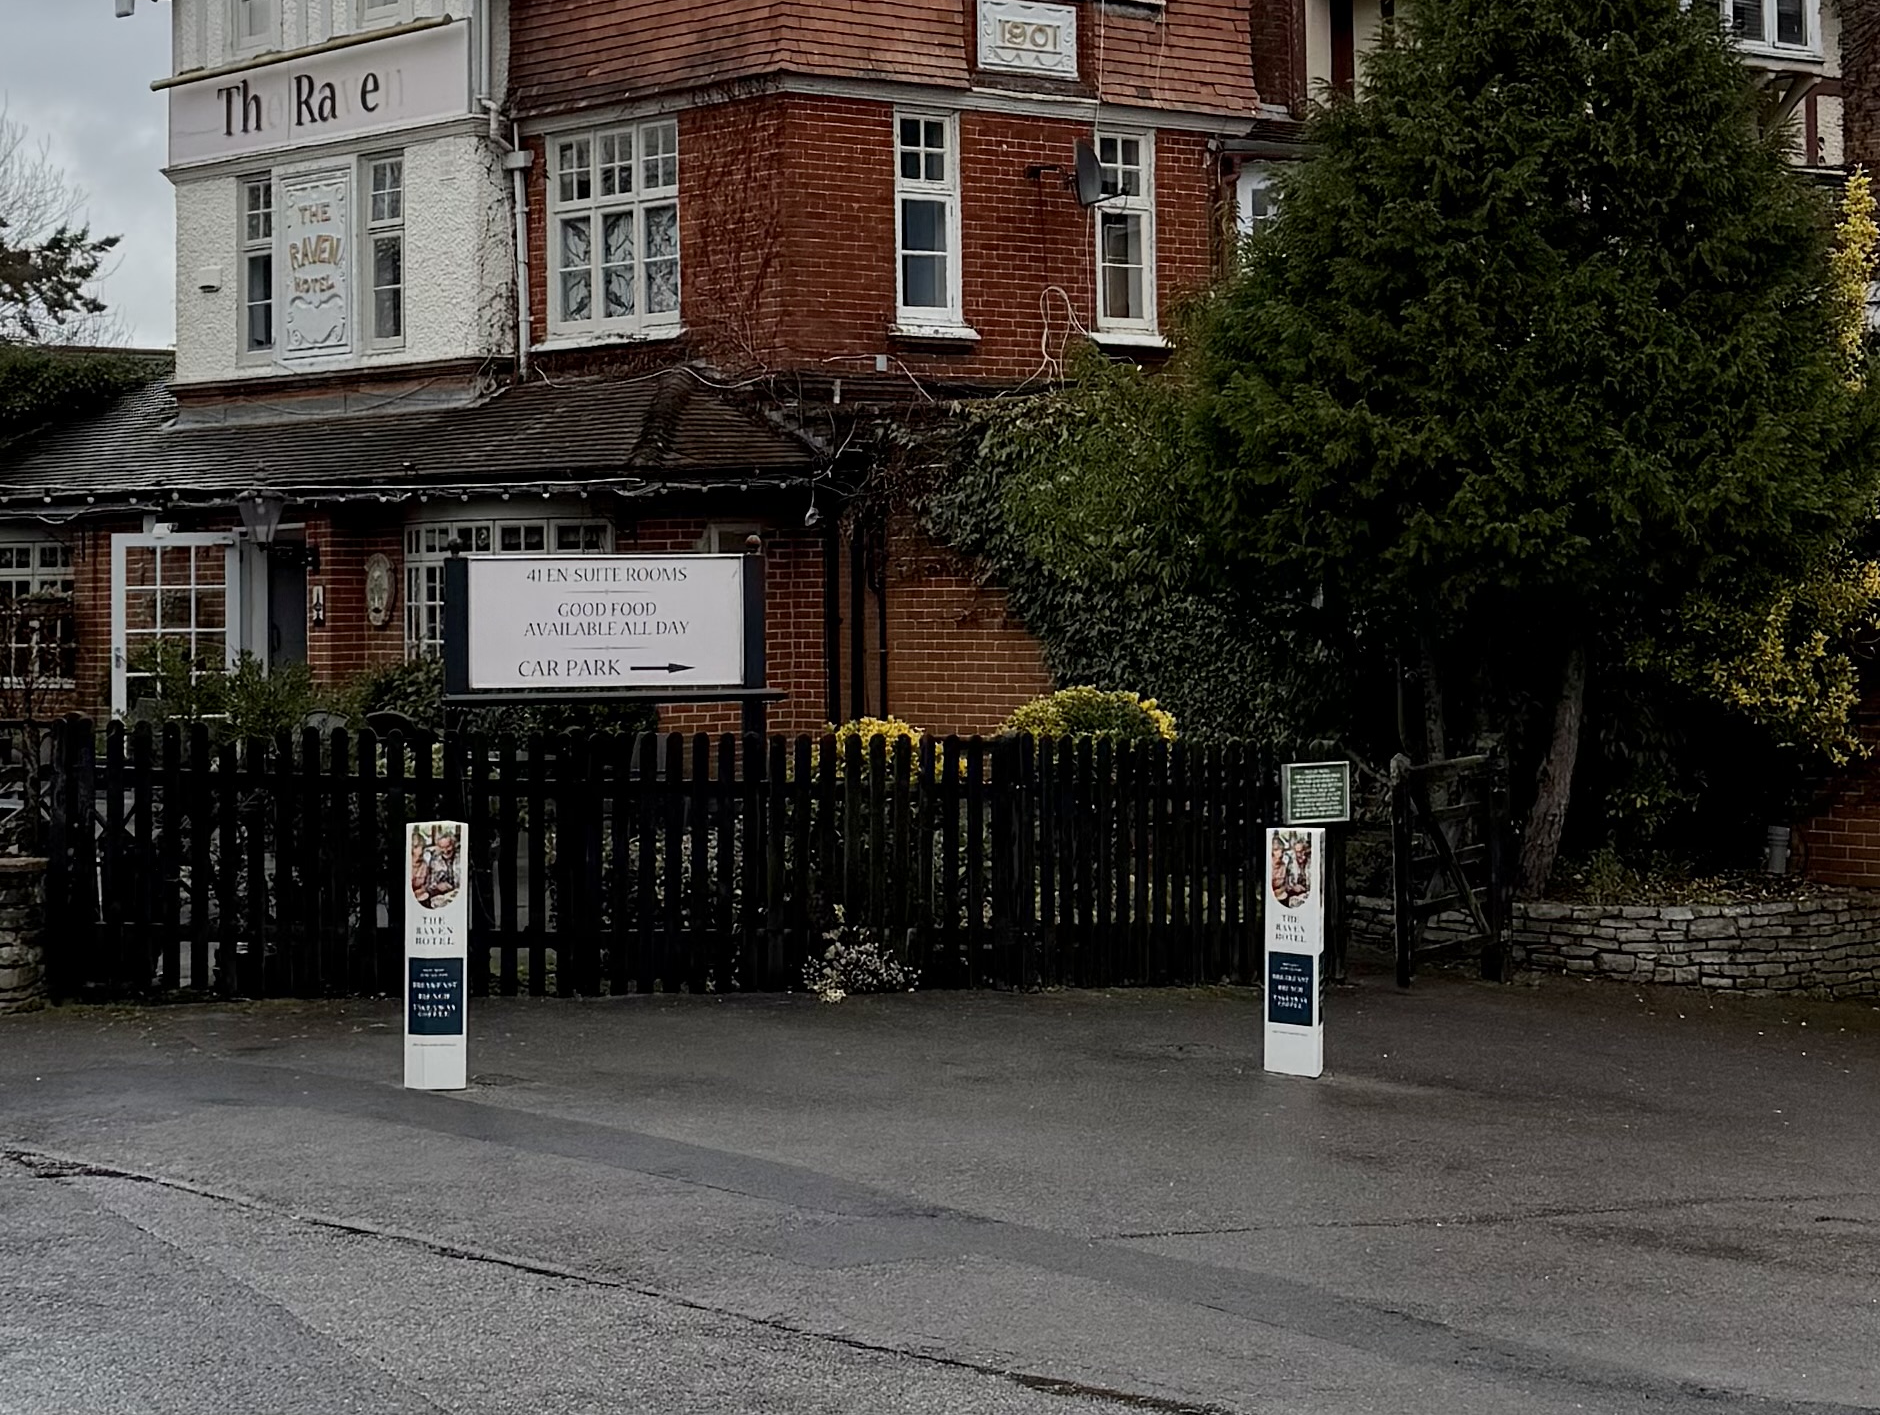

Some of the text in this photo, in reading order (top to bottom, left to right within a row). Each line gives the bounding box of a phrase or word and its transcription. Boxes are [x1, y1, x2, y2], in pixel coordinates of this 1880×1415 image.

[1000, 21, 1058, 49] 1901
[217, 78, 283, 136] Th
[298, 202, 331, 225] THE
[289, 235, 342, 270] RAVEN
[294, 275, 335, 293] HOTEL
[526, 568, 541, 582] 41
[626, 567, 687, 582] ROOMS
[558, 602, 657, 617] GOOD FOOD
[524, 621, 690, 636] AVAILABLE ALL DAY
[518, 659, 621, 677] CAR PARK
